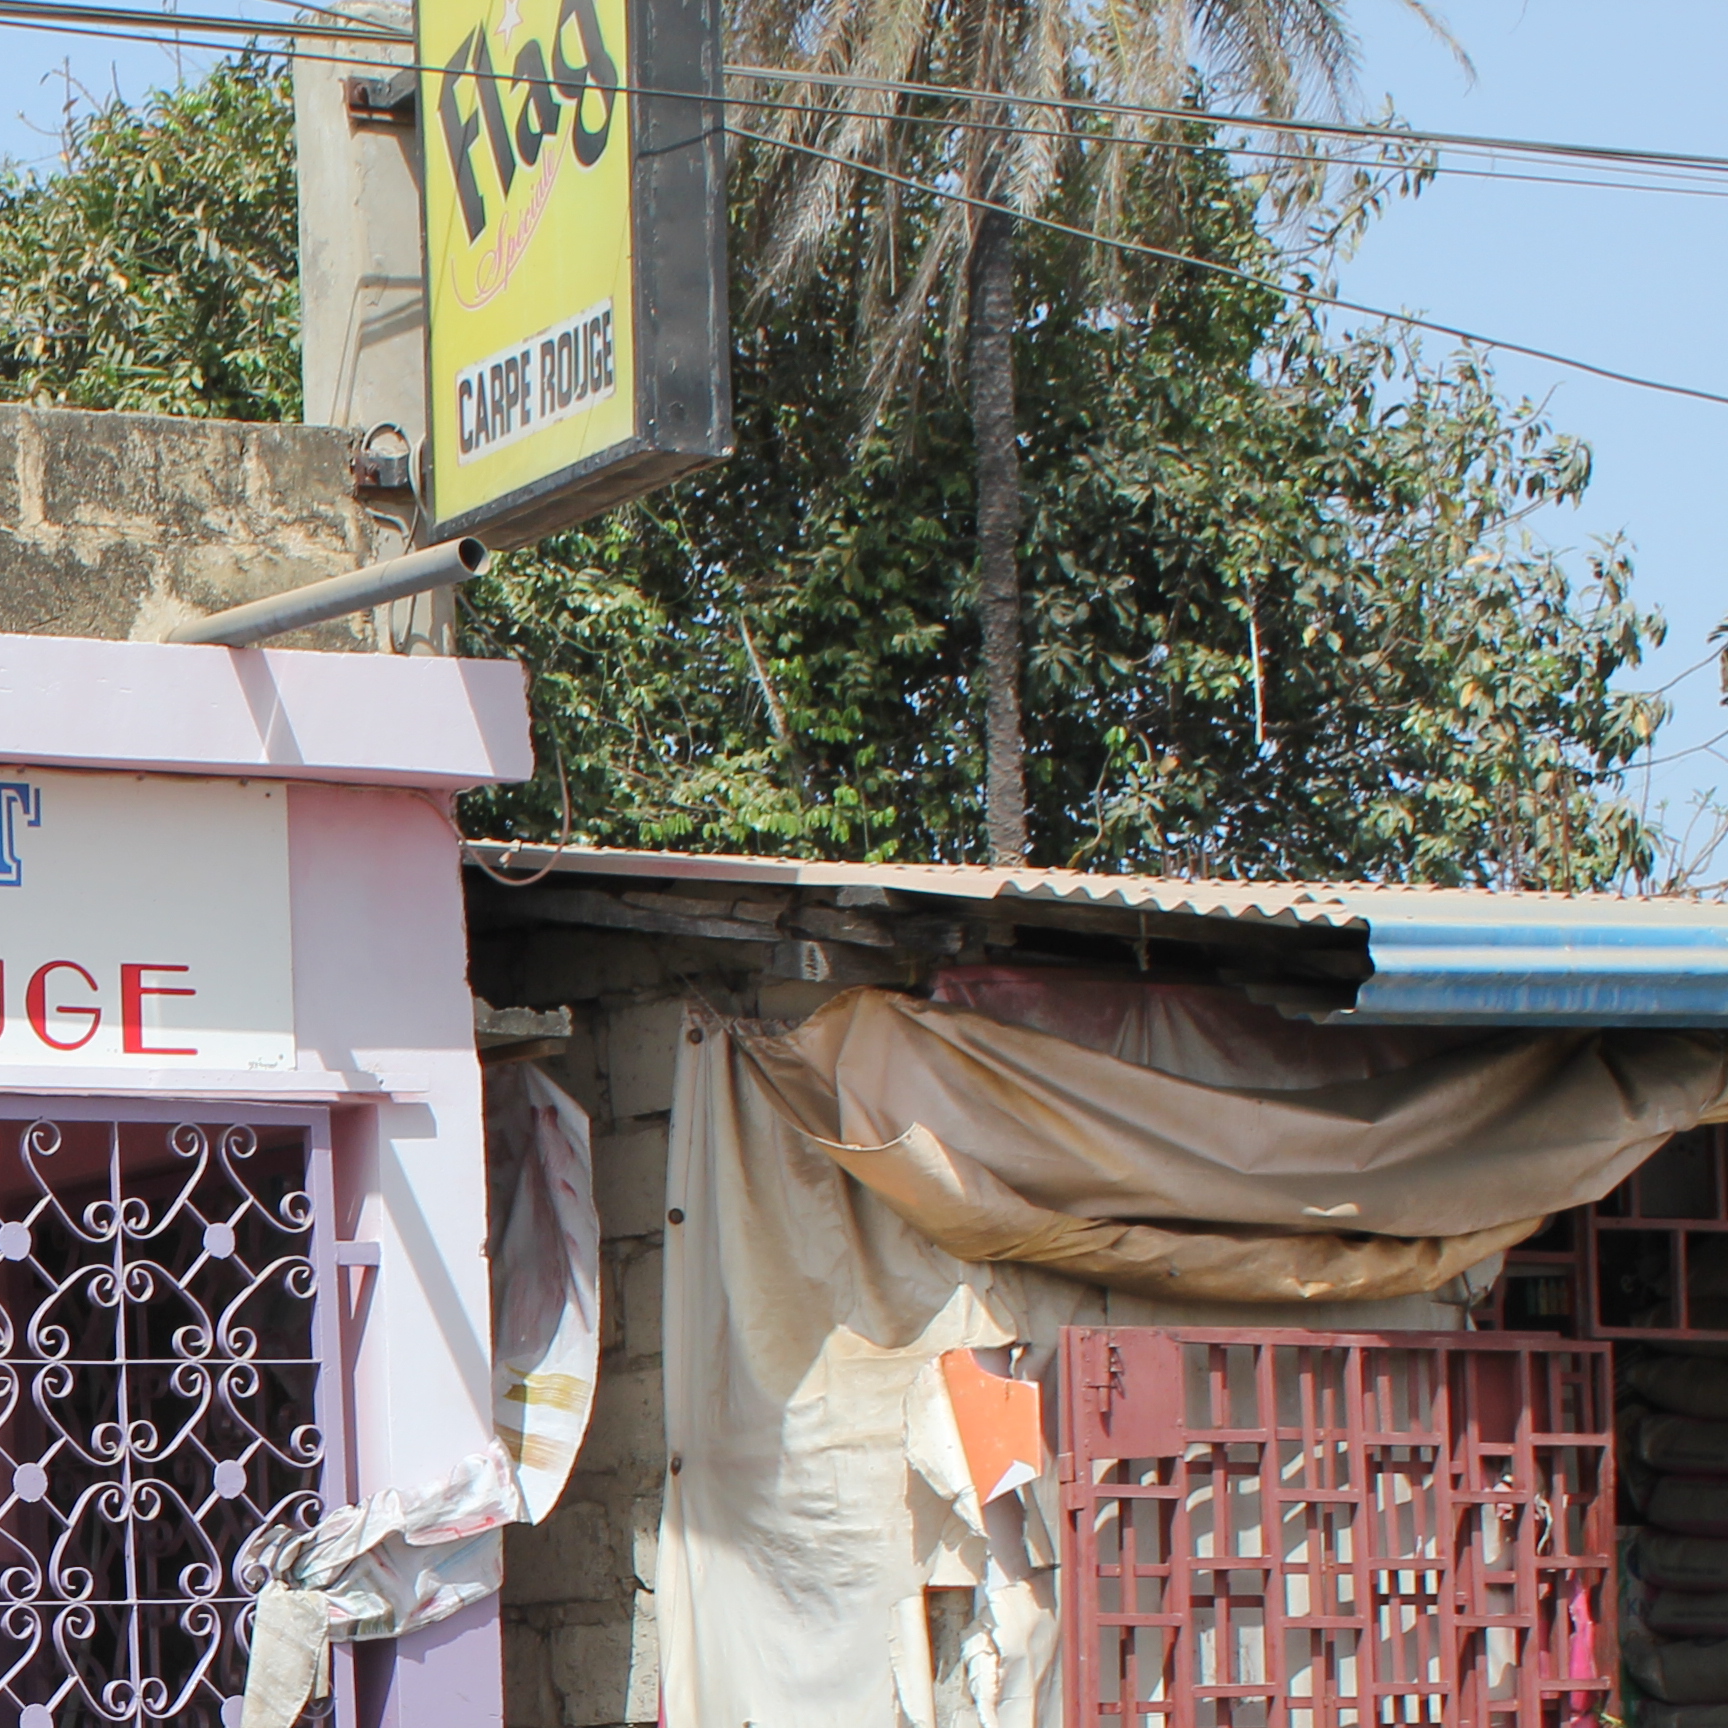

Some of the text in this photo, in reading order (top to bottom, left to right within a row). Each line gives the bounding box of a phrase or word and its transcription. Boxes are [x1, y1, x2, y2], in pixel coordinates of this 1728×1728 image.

[437, 0, 619, 247] Flag
[458, 309, 614, 455] CARPE ROUGE
